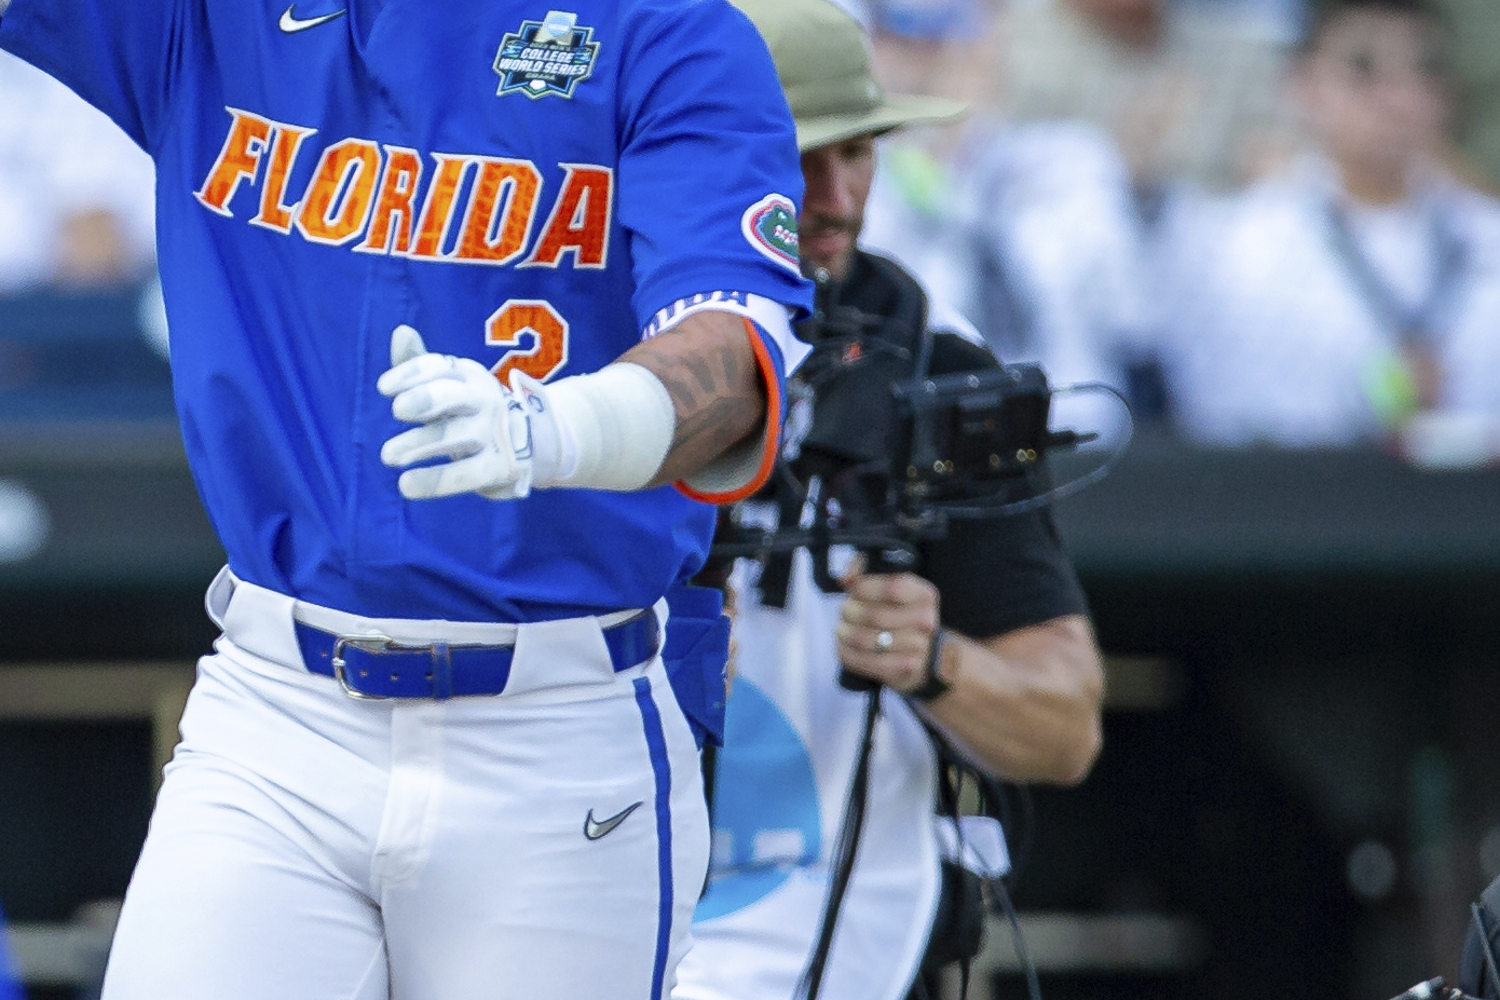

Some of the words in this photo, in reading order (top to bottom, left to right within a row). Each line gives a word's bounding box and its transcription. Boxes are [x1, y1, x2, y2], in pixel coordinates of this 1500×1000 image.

[499, 58, 544, 73] WORLD
[543, 61, 588, 75] SERIES
[520, 47, 575, 63] COLLEGE
[193, 105, 613, 269] FLORIDA
[485, 299, 568, 392] 2
